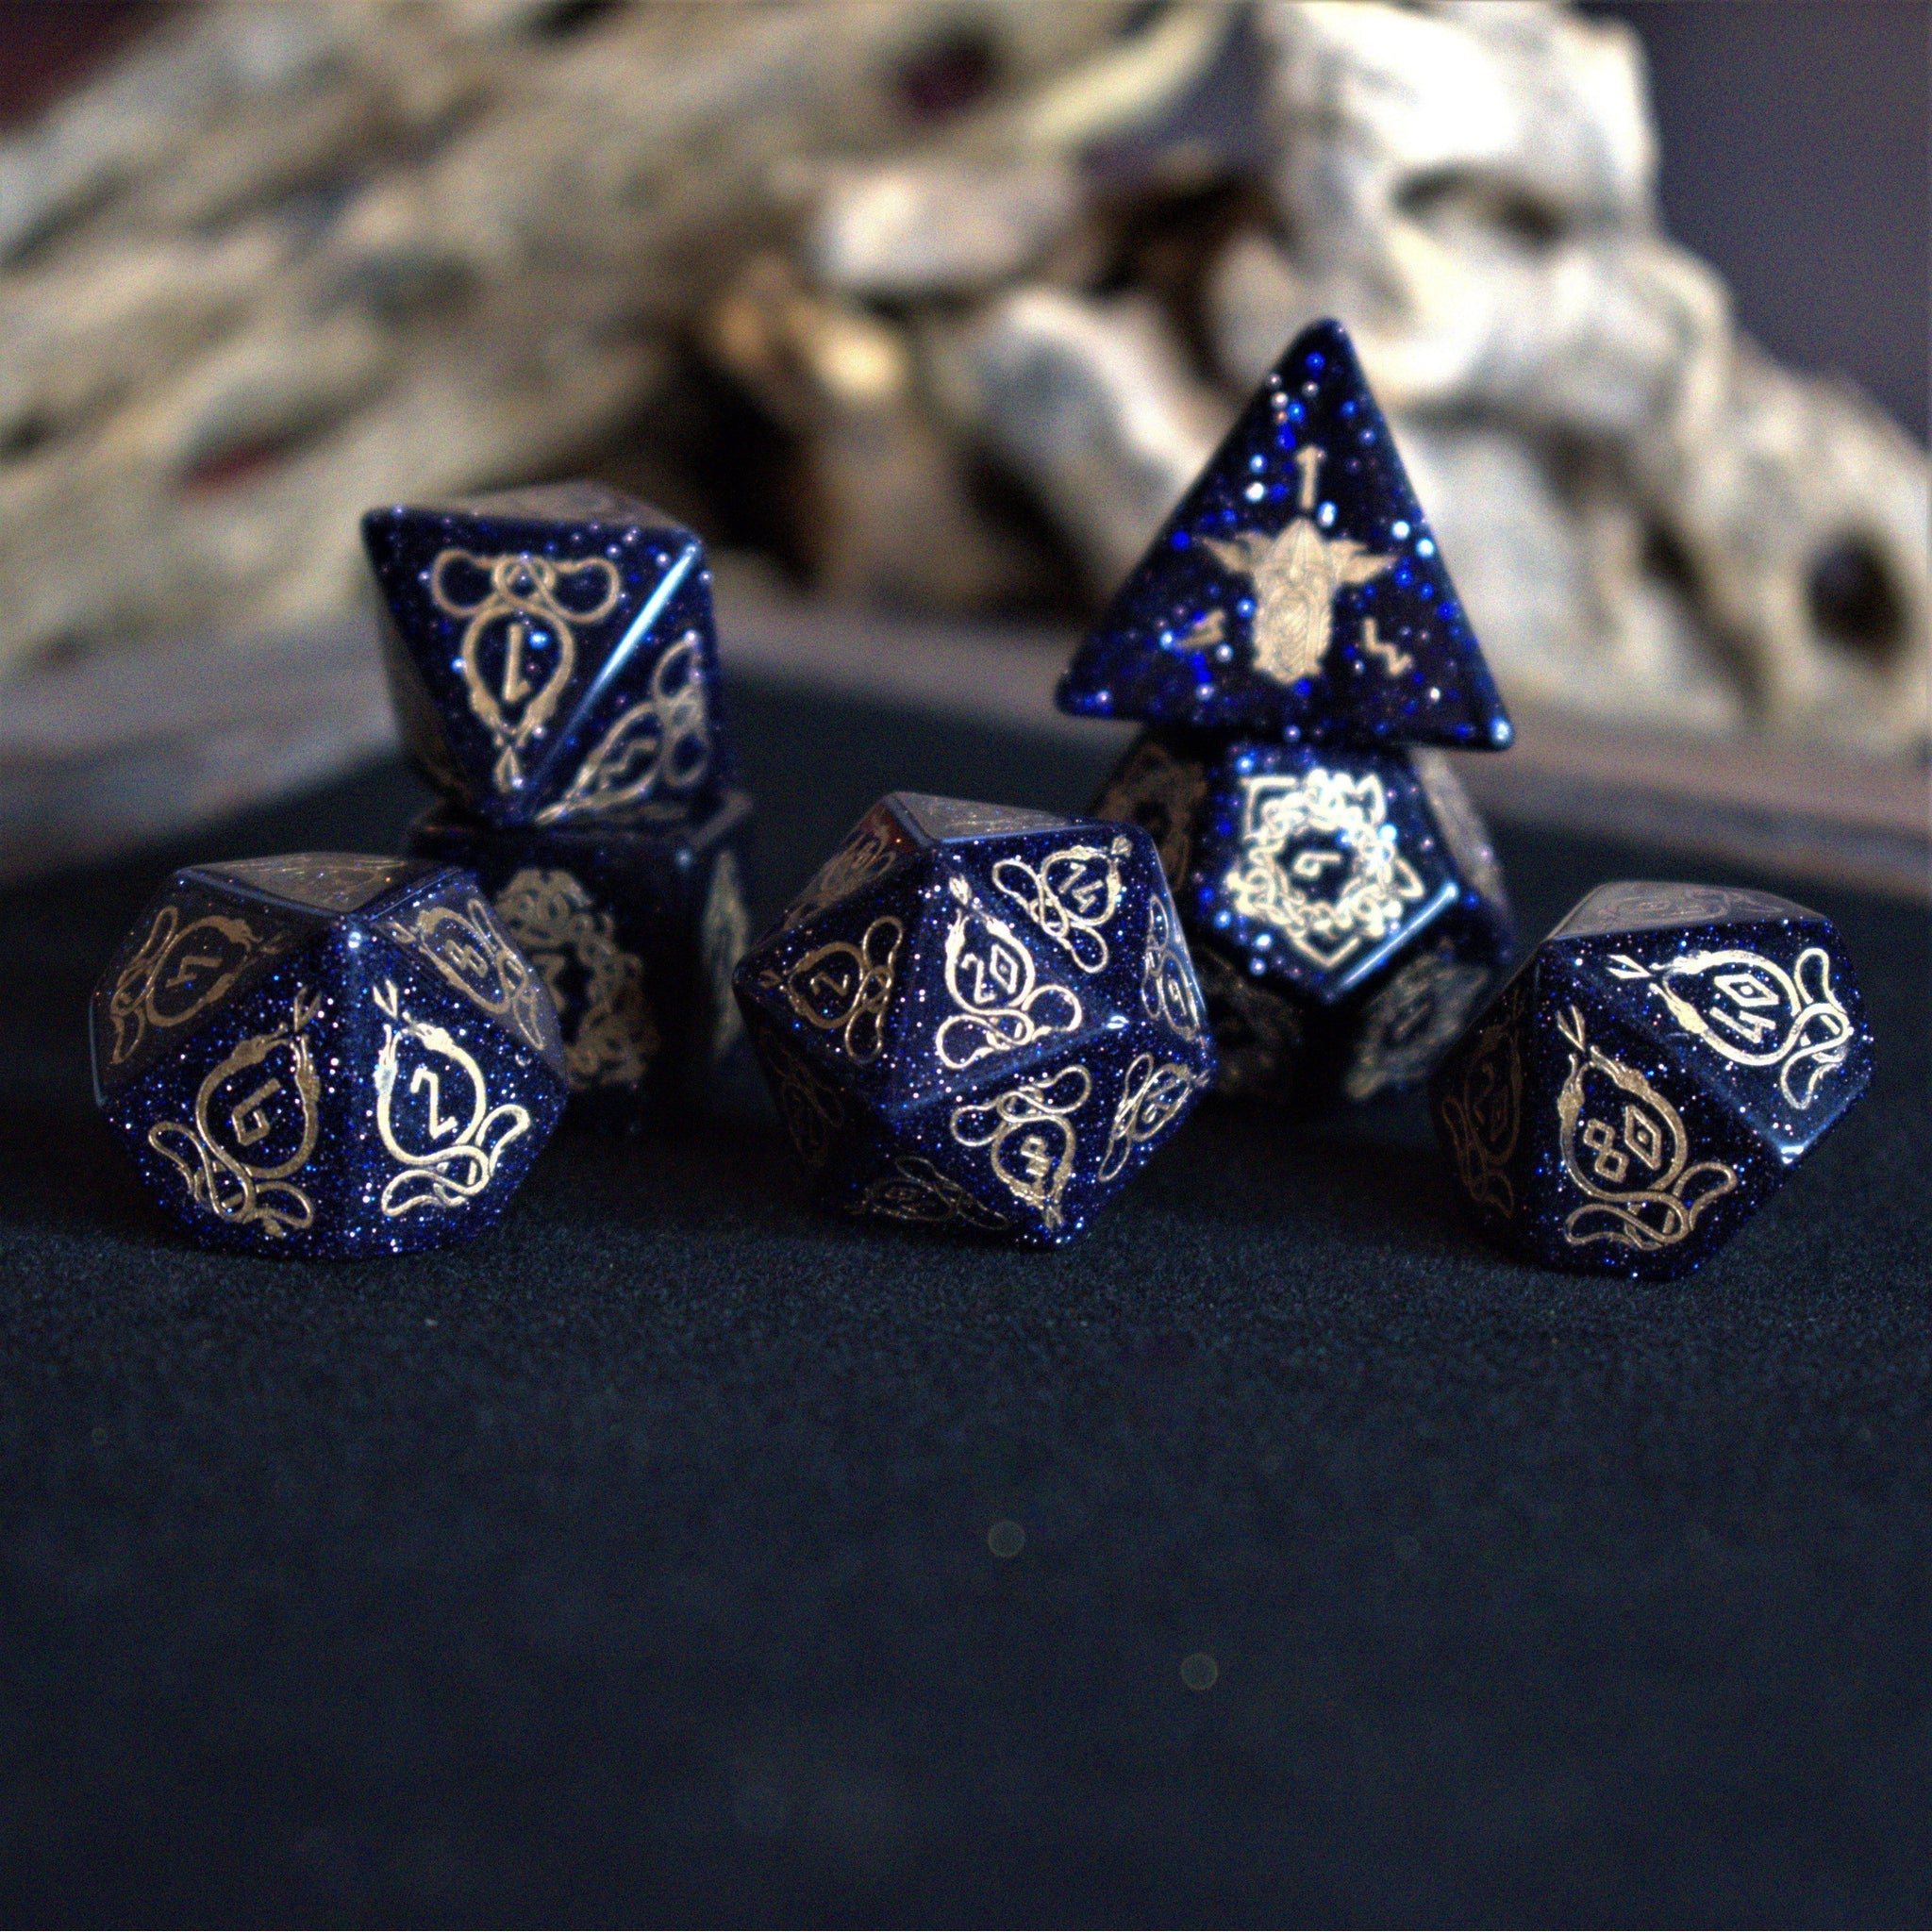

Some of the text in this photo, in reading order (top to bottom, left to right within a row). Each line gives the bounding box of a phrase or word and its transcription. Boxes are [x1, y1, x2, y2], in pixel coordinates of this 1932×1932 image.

[444, 939, 488, 976] 8
[810, 964, 851, 1001] 2
[960, 945, 1016, 1004] 20
[410, 1068, 458, 1141] 2
[1583, 1104, 1662, 1183] 80
